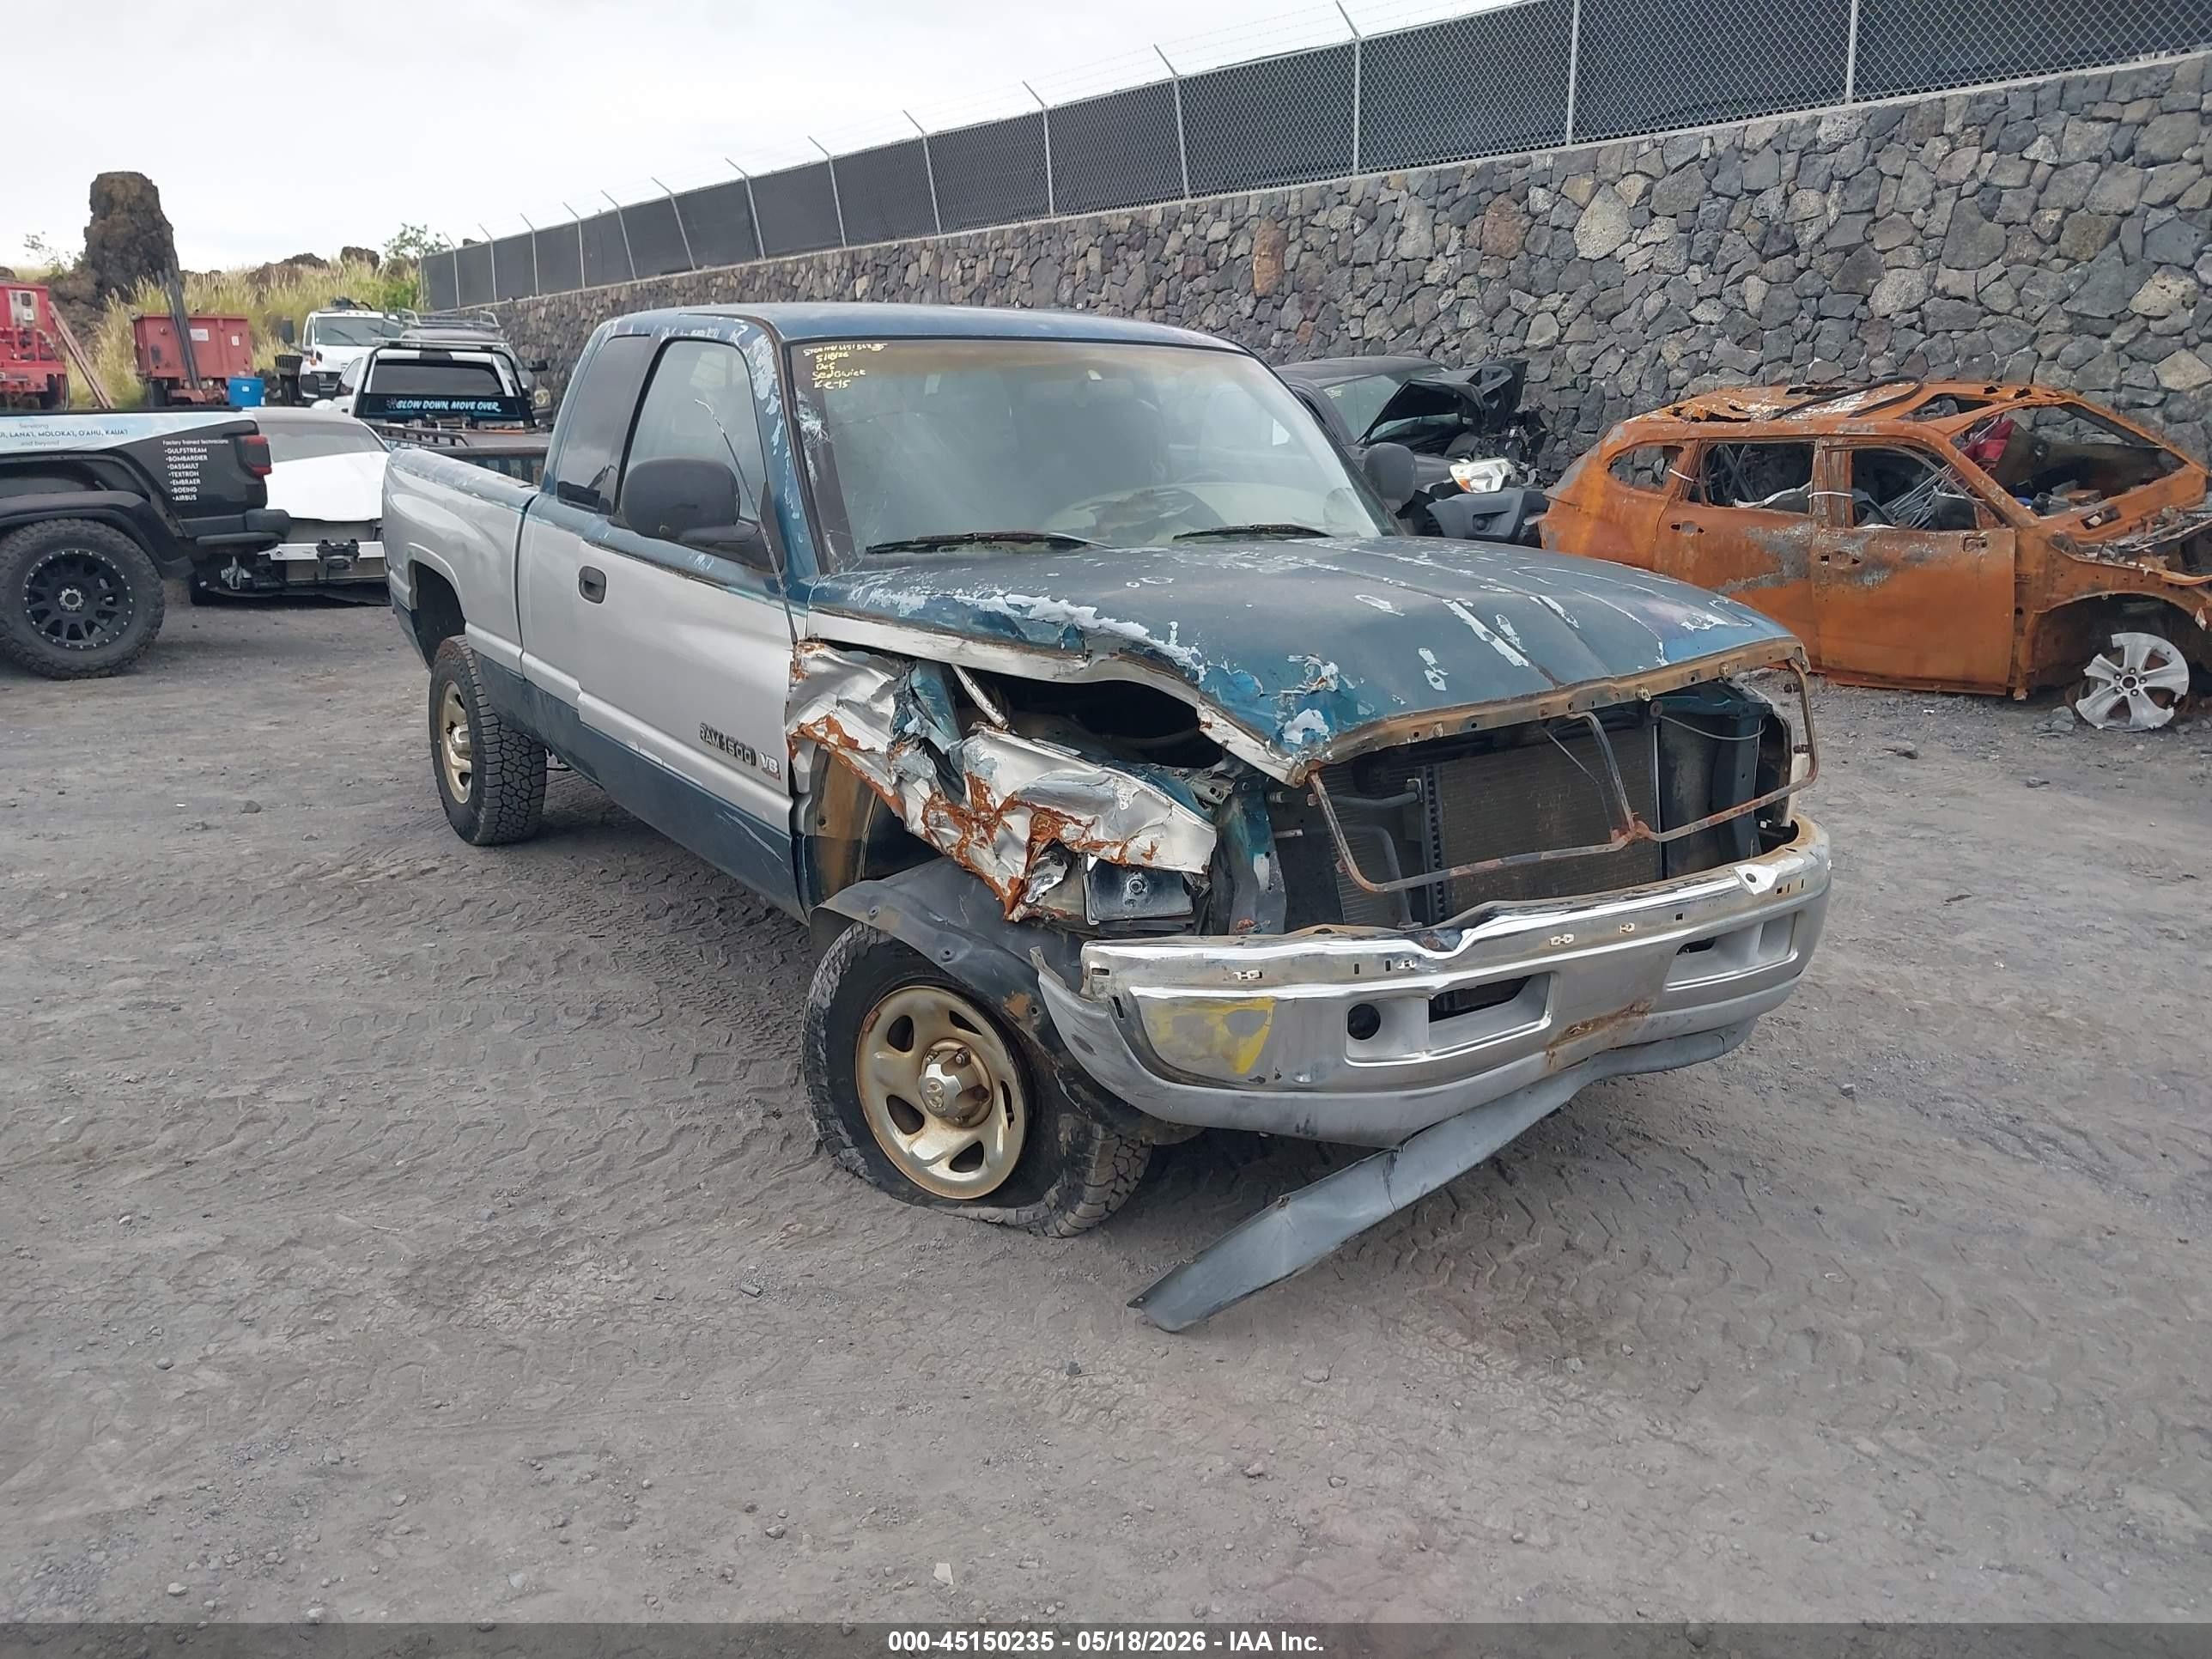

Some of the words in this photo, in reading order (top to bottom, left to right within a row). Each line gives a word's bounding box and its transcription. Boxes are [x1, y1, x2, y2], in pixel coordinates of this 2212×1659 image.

[396, 399, 422, 410] SLOW
[451, 400, 476, 410] MOVE
[477, 401, 502, 412] OVER
[699, 723, 721, 749] RAM
[721, 736, 757, 766] 1500
[759, 751, 780, 774] V8
